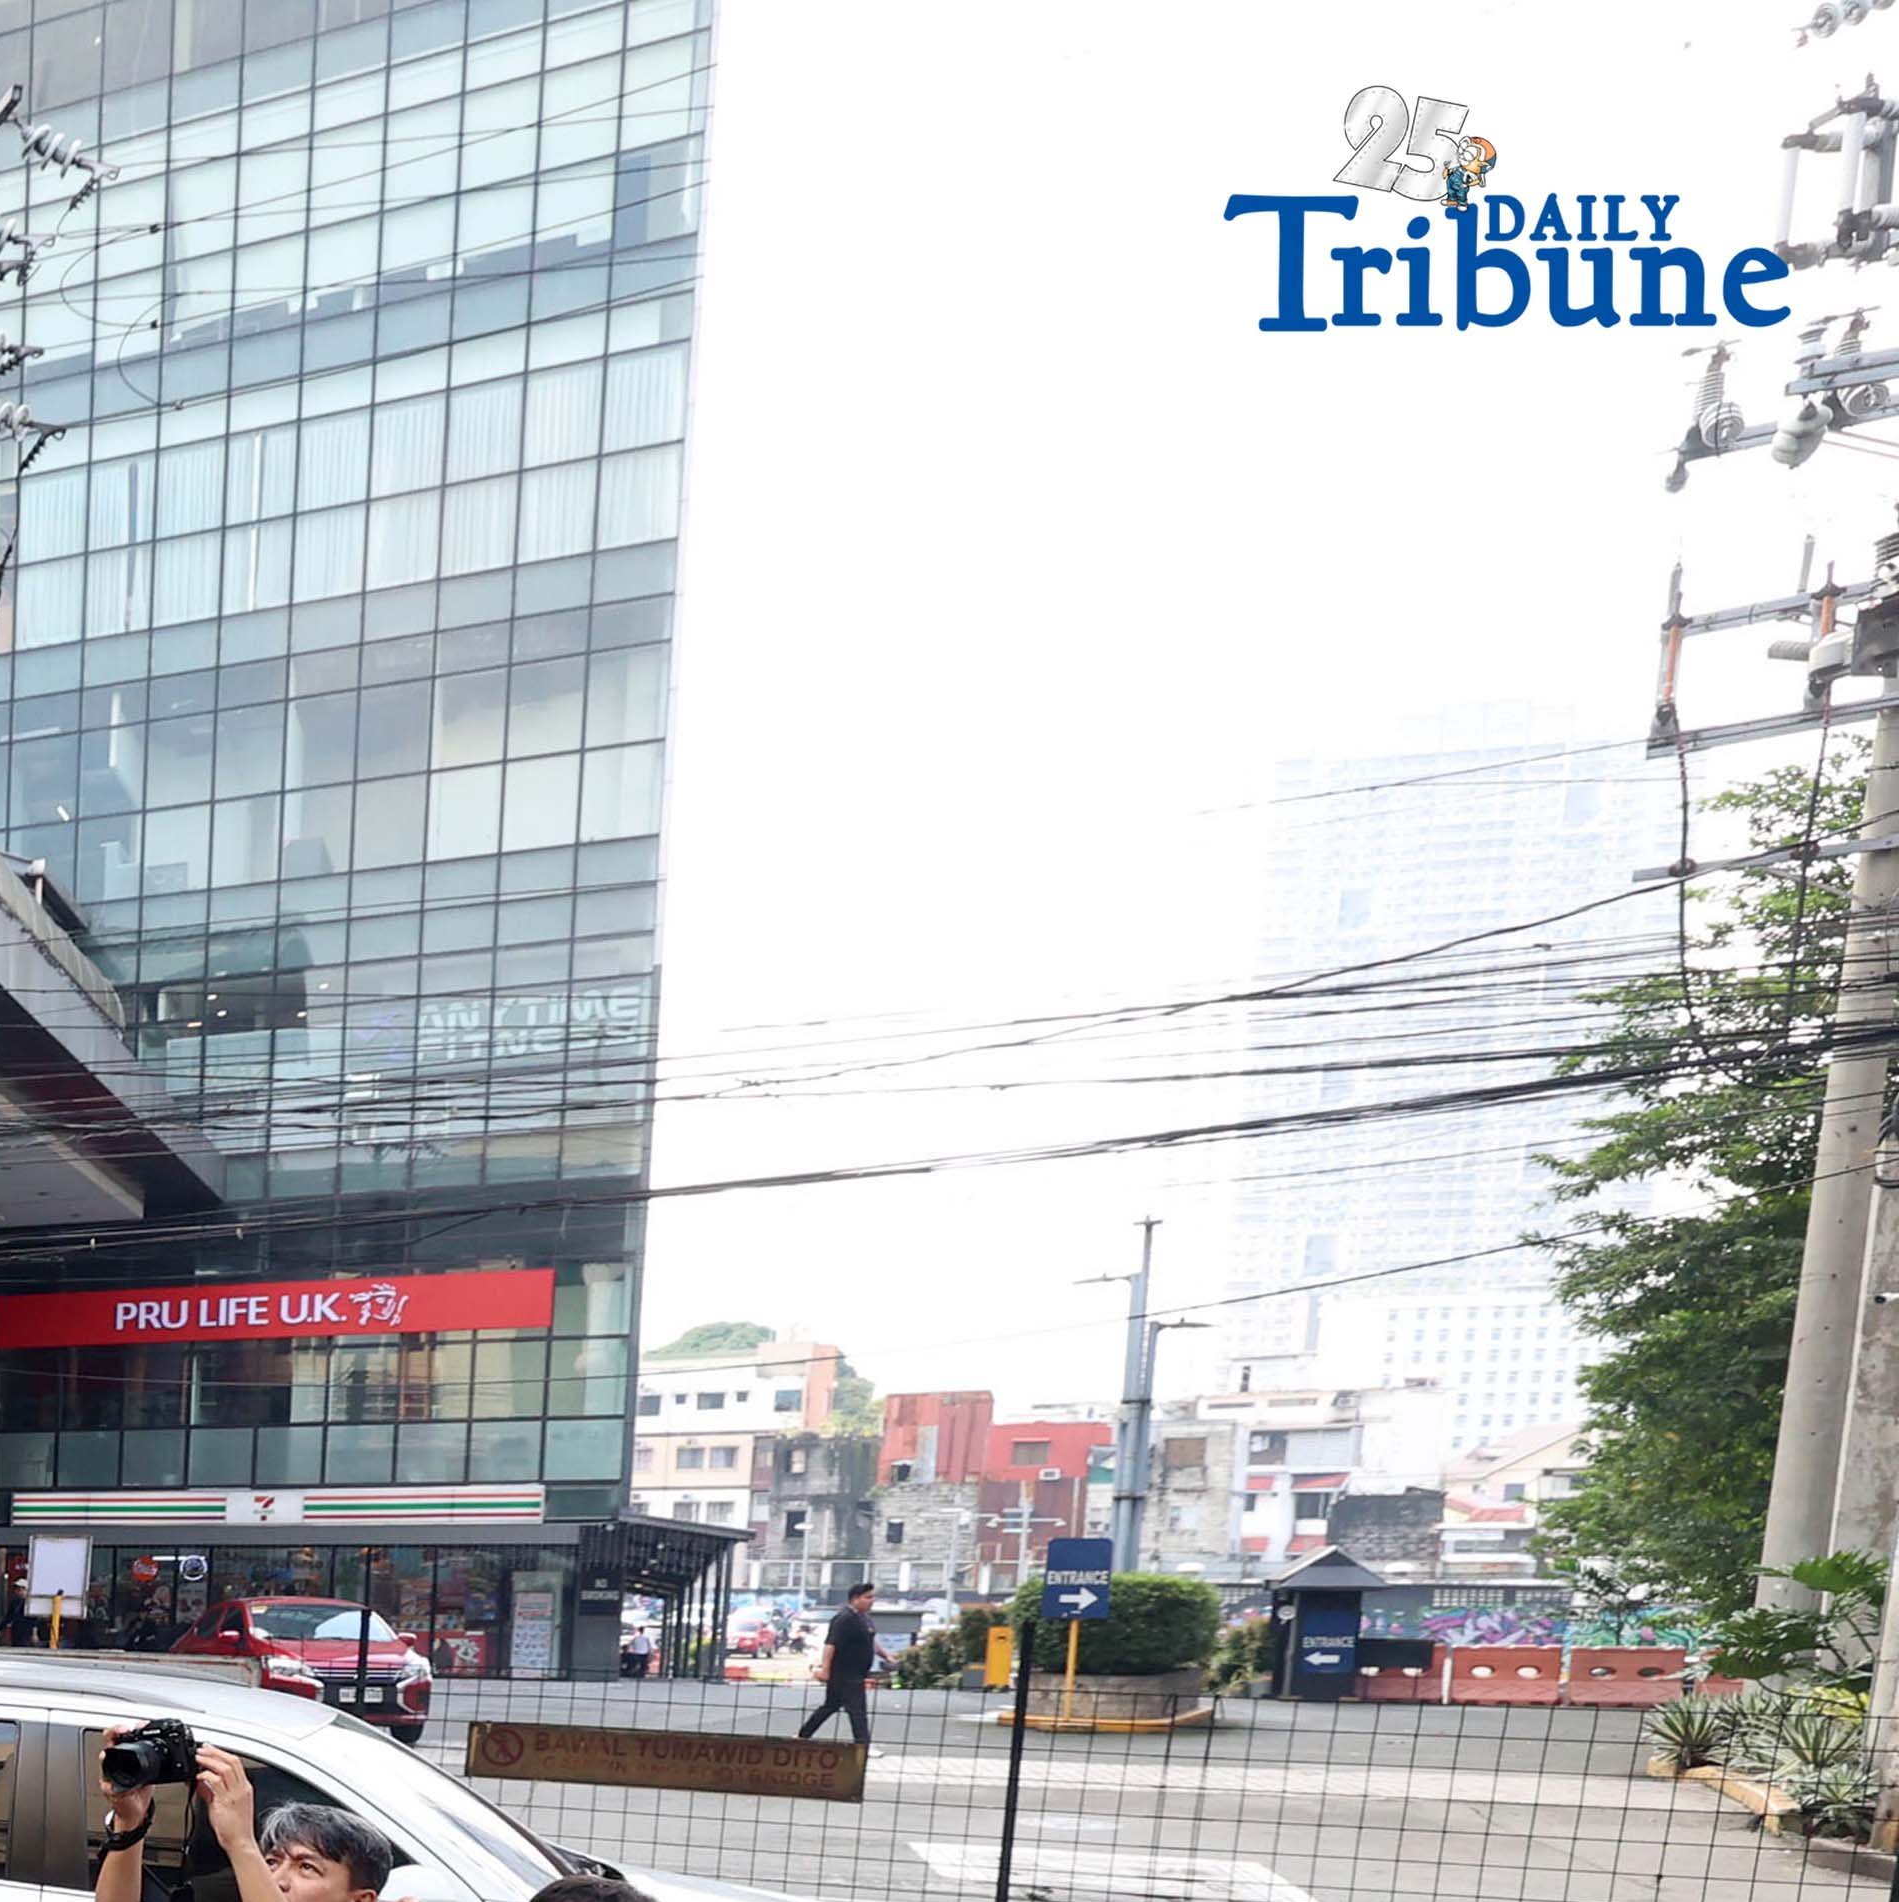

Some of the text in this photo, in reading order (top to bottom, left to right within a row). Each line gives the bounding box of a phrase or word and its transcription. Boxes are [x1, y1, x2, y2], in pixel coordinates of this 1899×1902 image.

[418, 985, 642, 1032] ANYTIME
[417, 1018, 641, 1063] FITNESS
[115, 1293, 347, 1330] PRU LIFE U.K.
[1047, 1570, 1109, 1587] ENTRANCE
[1303, 1636, 1355, 1649] ENTRANCE
[534, 1731, 839, 1770] BAWAL TUMAWID DITO
